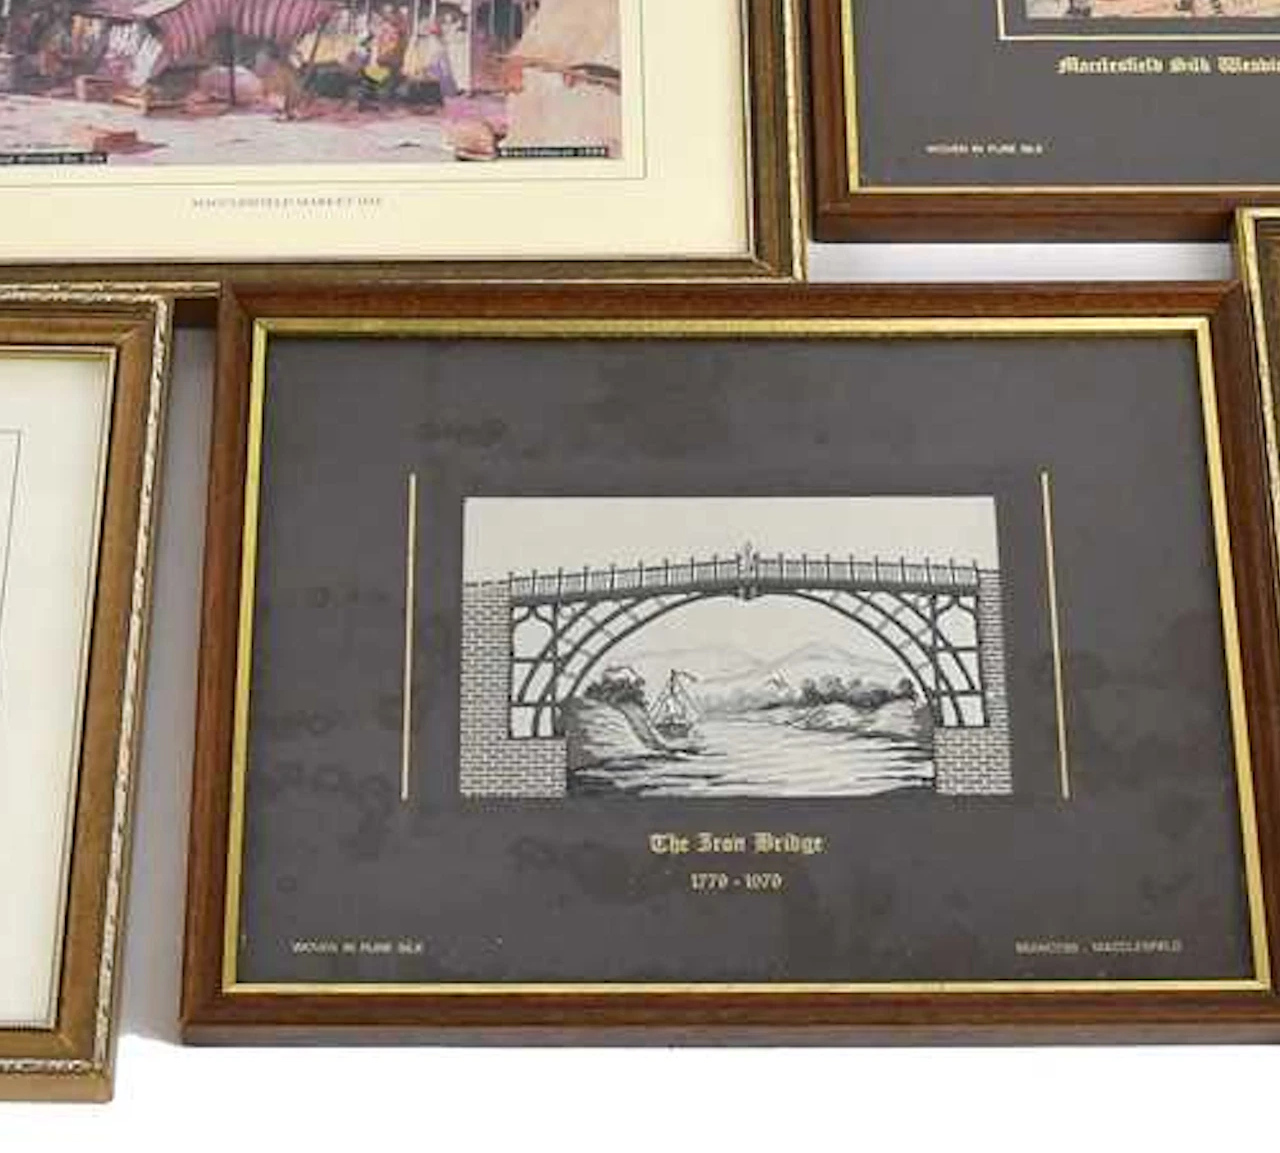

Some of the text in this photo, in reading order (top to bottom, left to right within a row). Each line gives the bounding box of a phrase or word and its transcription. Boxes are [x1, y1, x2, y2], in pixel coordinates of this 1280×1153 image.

[1058, 56, 1163, 75] Macclesfield
[1169, 56, 1211, 75] Silk
[649, 832, 825, 855] The Iron Bridge
